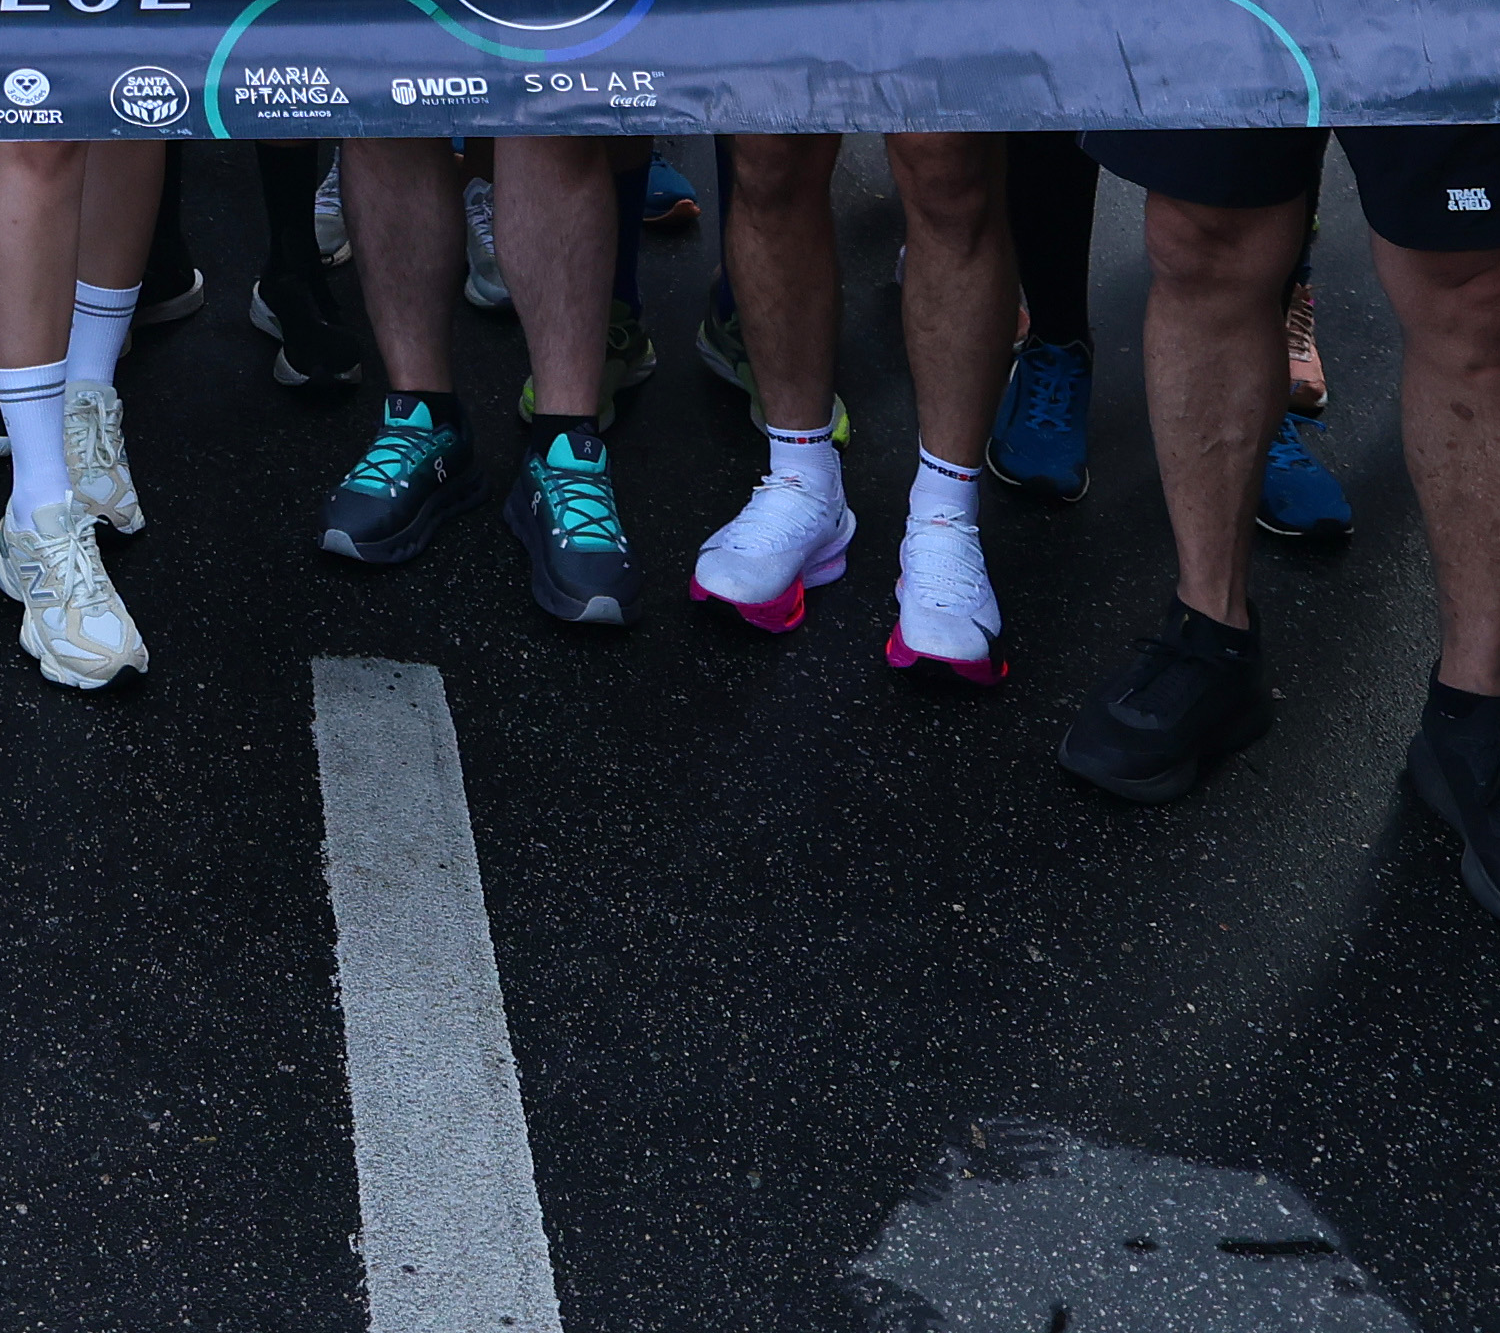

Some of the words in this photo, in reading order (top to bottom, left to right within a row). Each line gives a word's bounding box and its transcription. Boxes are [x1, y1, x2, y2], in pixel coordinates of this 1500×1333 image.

[128, 76, 170, 86] SANTA
[244, 67, 331, 85] MARIA
[525, 71, 655, 92] SOLAR
[123, 85, 176, 97] CLARA
[417, 77, 488, 95] WOD
[235, 87, 350, 105] PITANGA
[421, 97, 490, 106] NUTRITION
[291, 109, 332, 118] GELATOS
[1447, 188, 1487, 200] TRACK
[1448, 200, 1458, 211] &
[1459, 199, 1491, 211] FIELD
